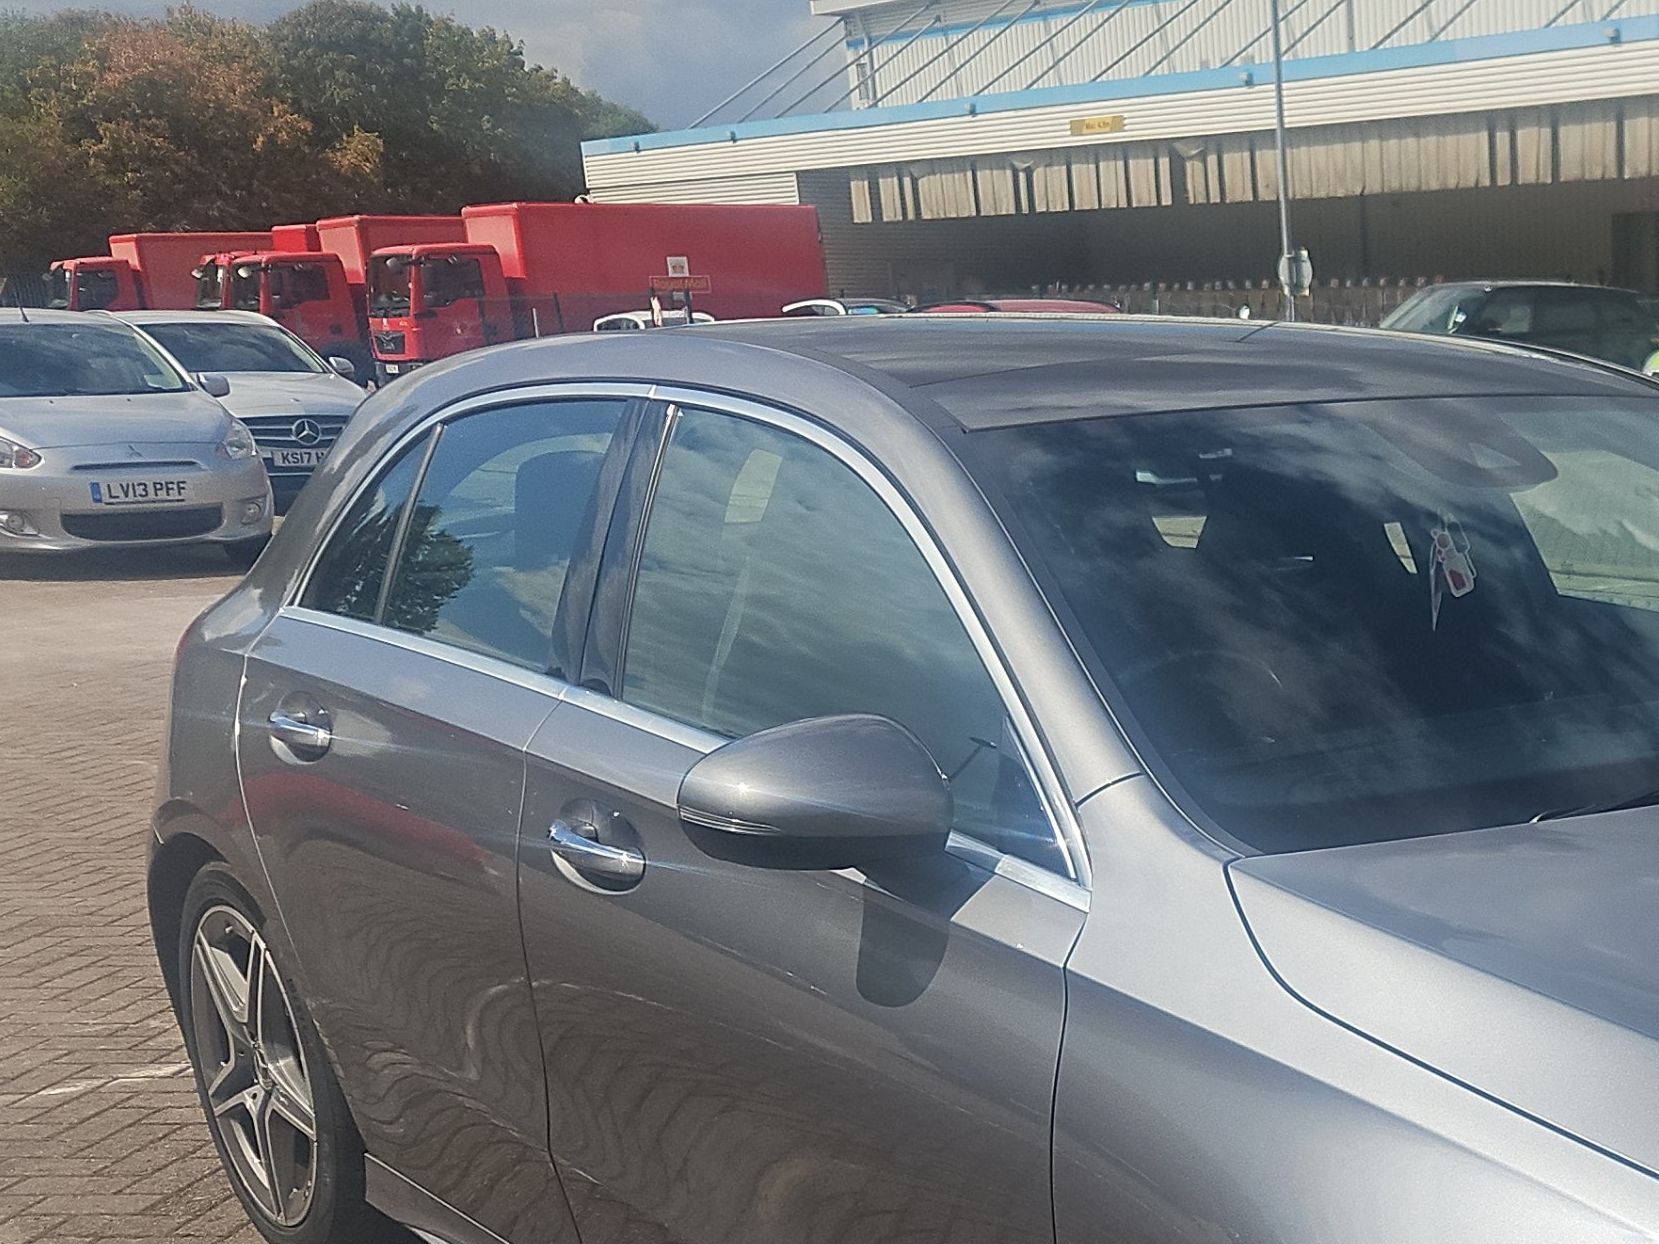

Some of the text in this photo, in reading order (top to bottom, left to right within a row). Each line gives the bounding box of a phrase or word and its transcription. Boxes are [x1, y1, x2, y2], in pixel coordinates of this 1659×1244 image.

[281, 451, 312, 465] KS17
[106, 480, 187, 499] LV13 PFF
